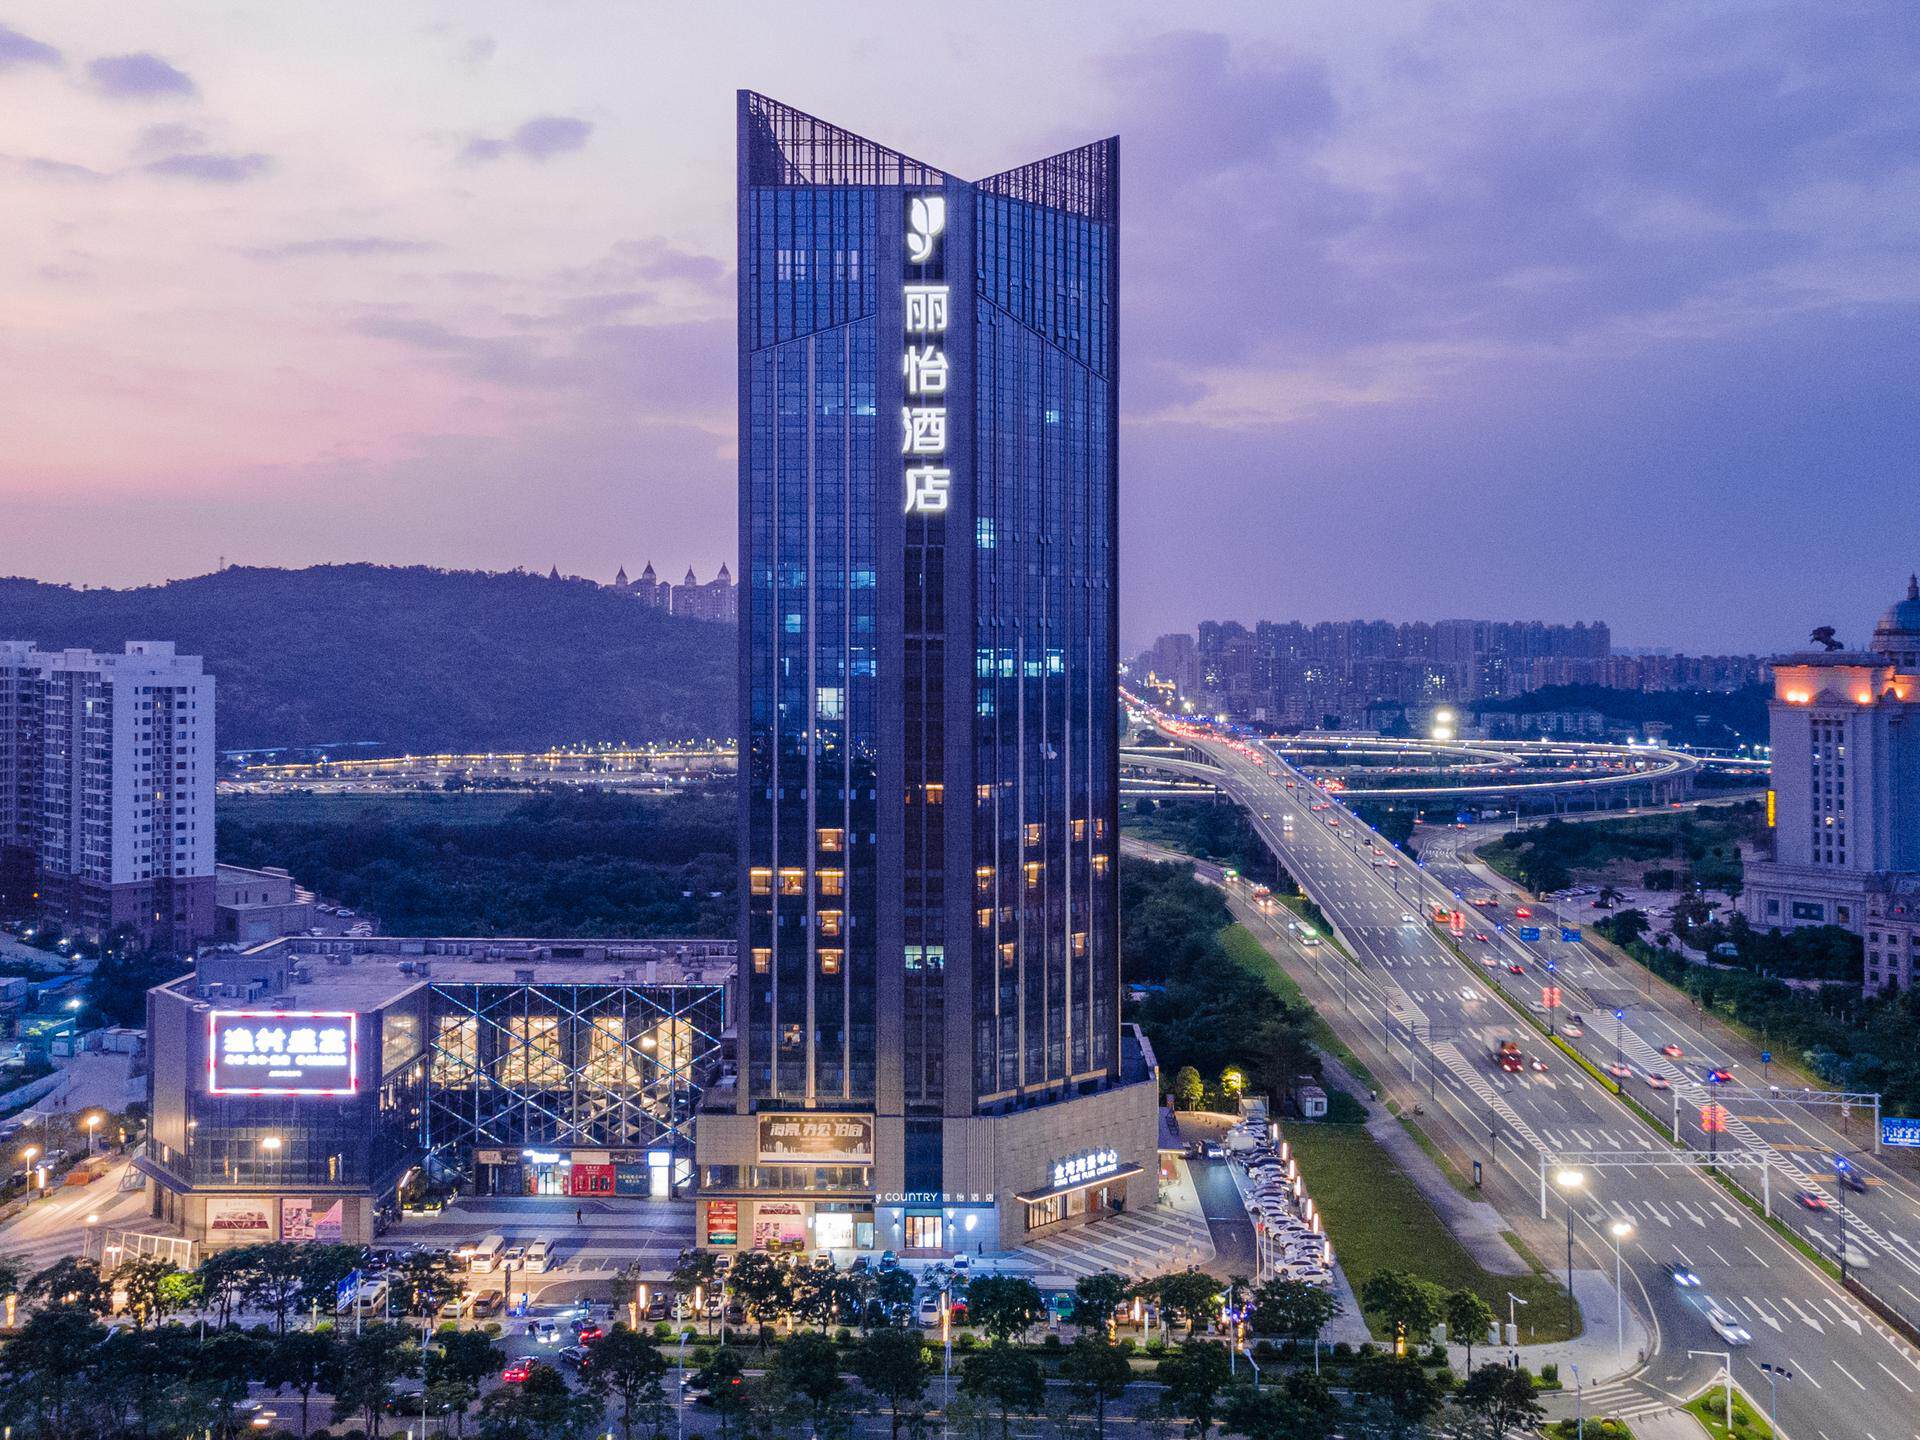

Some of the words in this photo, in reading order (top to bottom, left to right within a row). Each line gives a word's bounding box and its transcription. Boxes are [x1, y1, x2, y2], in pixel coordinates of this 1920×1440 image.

[901, 286, 950, 514] 丽怡酒店
[885, 1192, 938, 1202] COUNTRY
